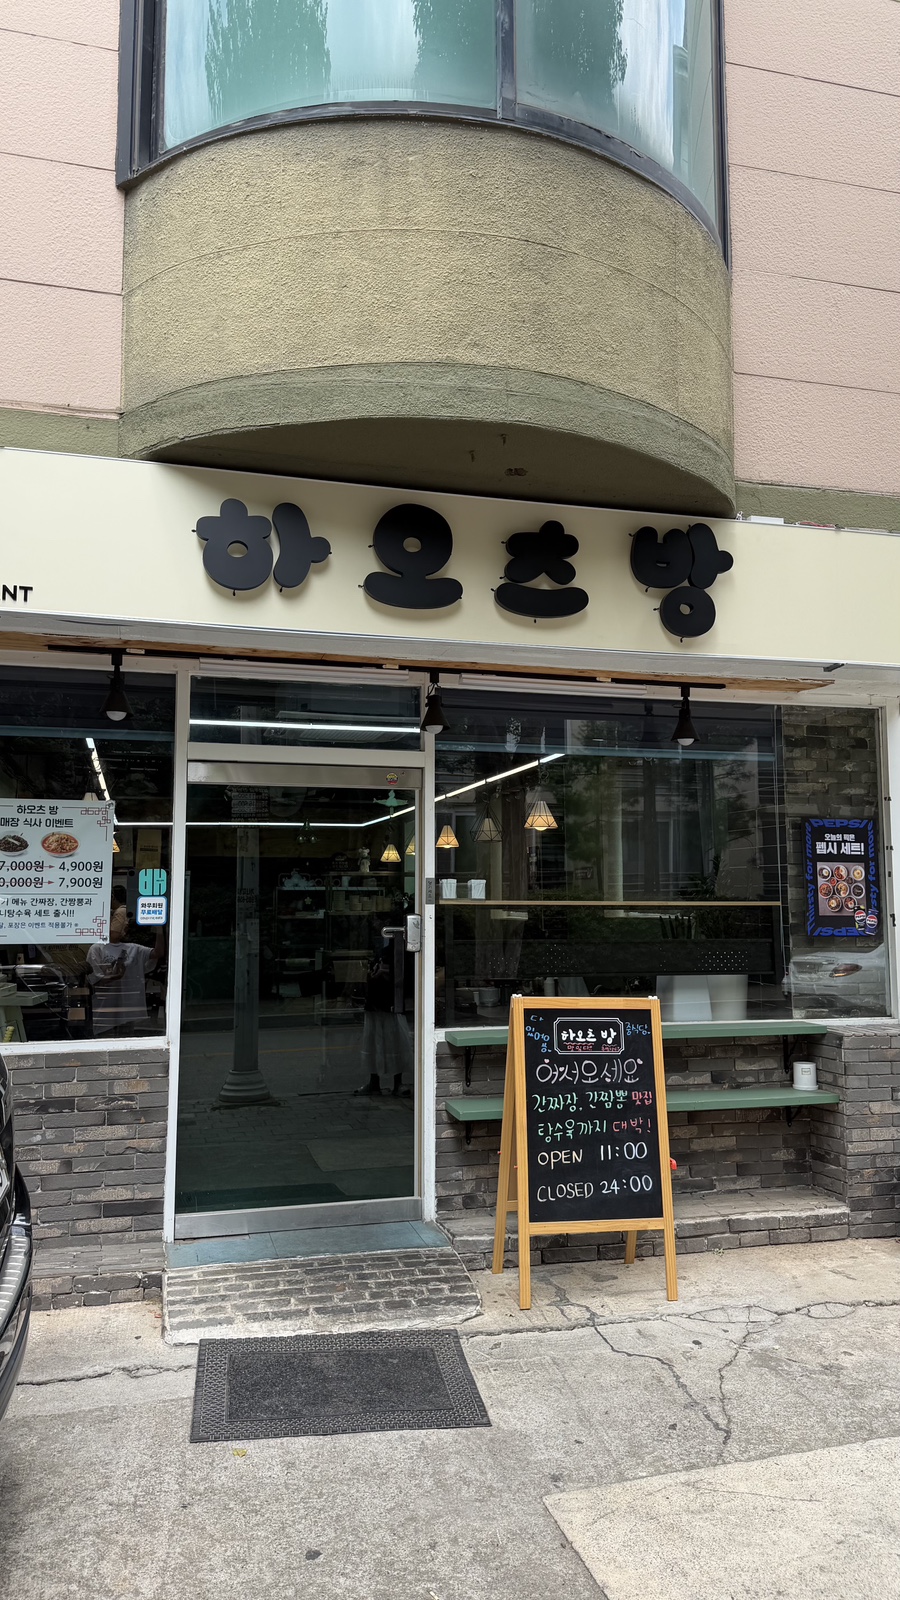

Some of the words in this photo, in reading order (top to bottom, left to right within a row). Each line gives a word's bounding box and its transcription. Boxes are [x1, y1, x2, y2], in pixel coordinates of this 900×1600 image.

[16, 804, 46, 815] 하오츠
[48, 804, 59, 816] 방
[0, 817, 20, 828] 매장
[23, 818, 43, 829] 식사
[45, 818, 74, 829] 이벤트
[809, 819, 868, 828] PEPSI
[815, 841, 838, 855] 펩시
[840, 842, 865, 855] 세트!
[58, 860, 104, 872] 4,900원
[58, 876, 103, 888] 7,900원
[12, 897, 28, 907] 메뉴
[34, 909, 50, 918] 세트
[53, 909, 75, 918] 출시!!
[807, 883, 815, 936] Thirsty
[560, 1028, 597, 1042] 하오츠
[600, 1027, 617, 1045] 방
[535, 1058, 641, 1084] 어서오세요
[585, 1089, 629, 1110] 간짬뽕
[631, 1090, 653, 1106] 맛집
[537, 1118, 607, 1143] 탕수육까지
[537, 1148, 583, 1170] OPEN
[600, 1141, 648, 1161] 11:00
[536, 1181, 594, 1203] CLOSED
[599, 1174, 653, 1195] 24:00
